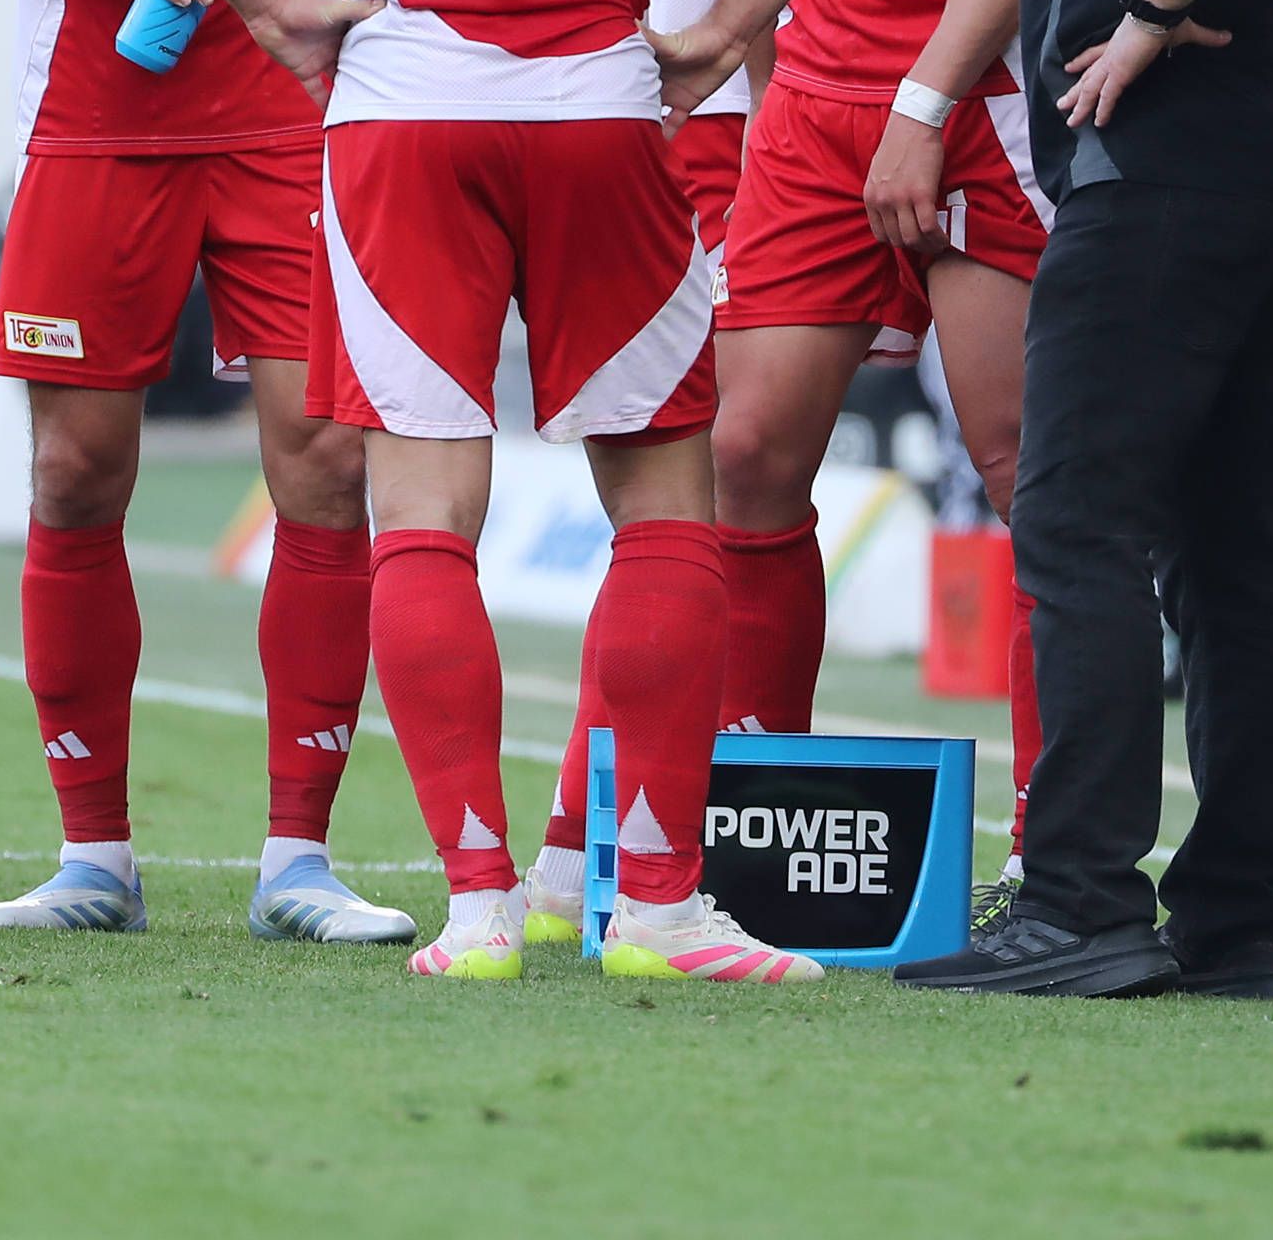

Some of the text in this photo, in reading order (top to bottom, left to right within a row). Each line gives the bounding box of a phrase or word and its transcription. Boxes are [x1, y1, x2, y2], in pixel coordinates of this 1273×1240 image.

[43, 332, 75, 349] UNION
[704, 806, 890, 852] POWER
[787, 851, 890, 895] ADE
